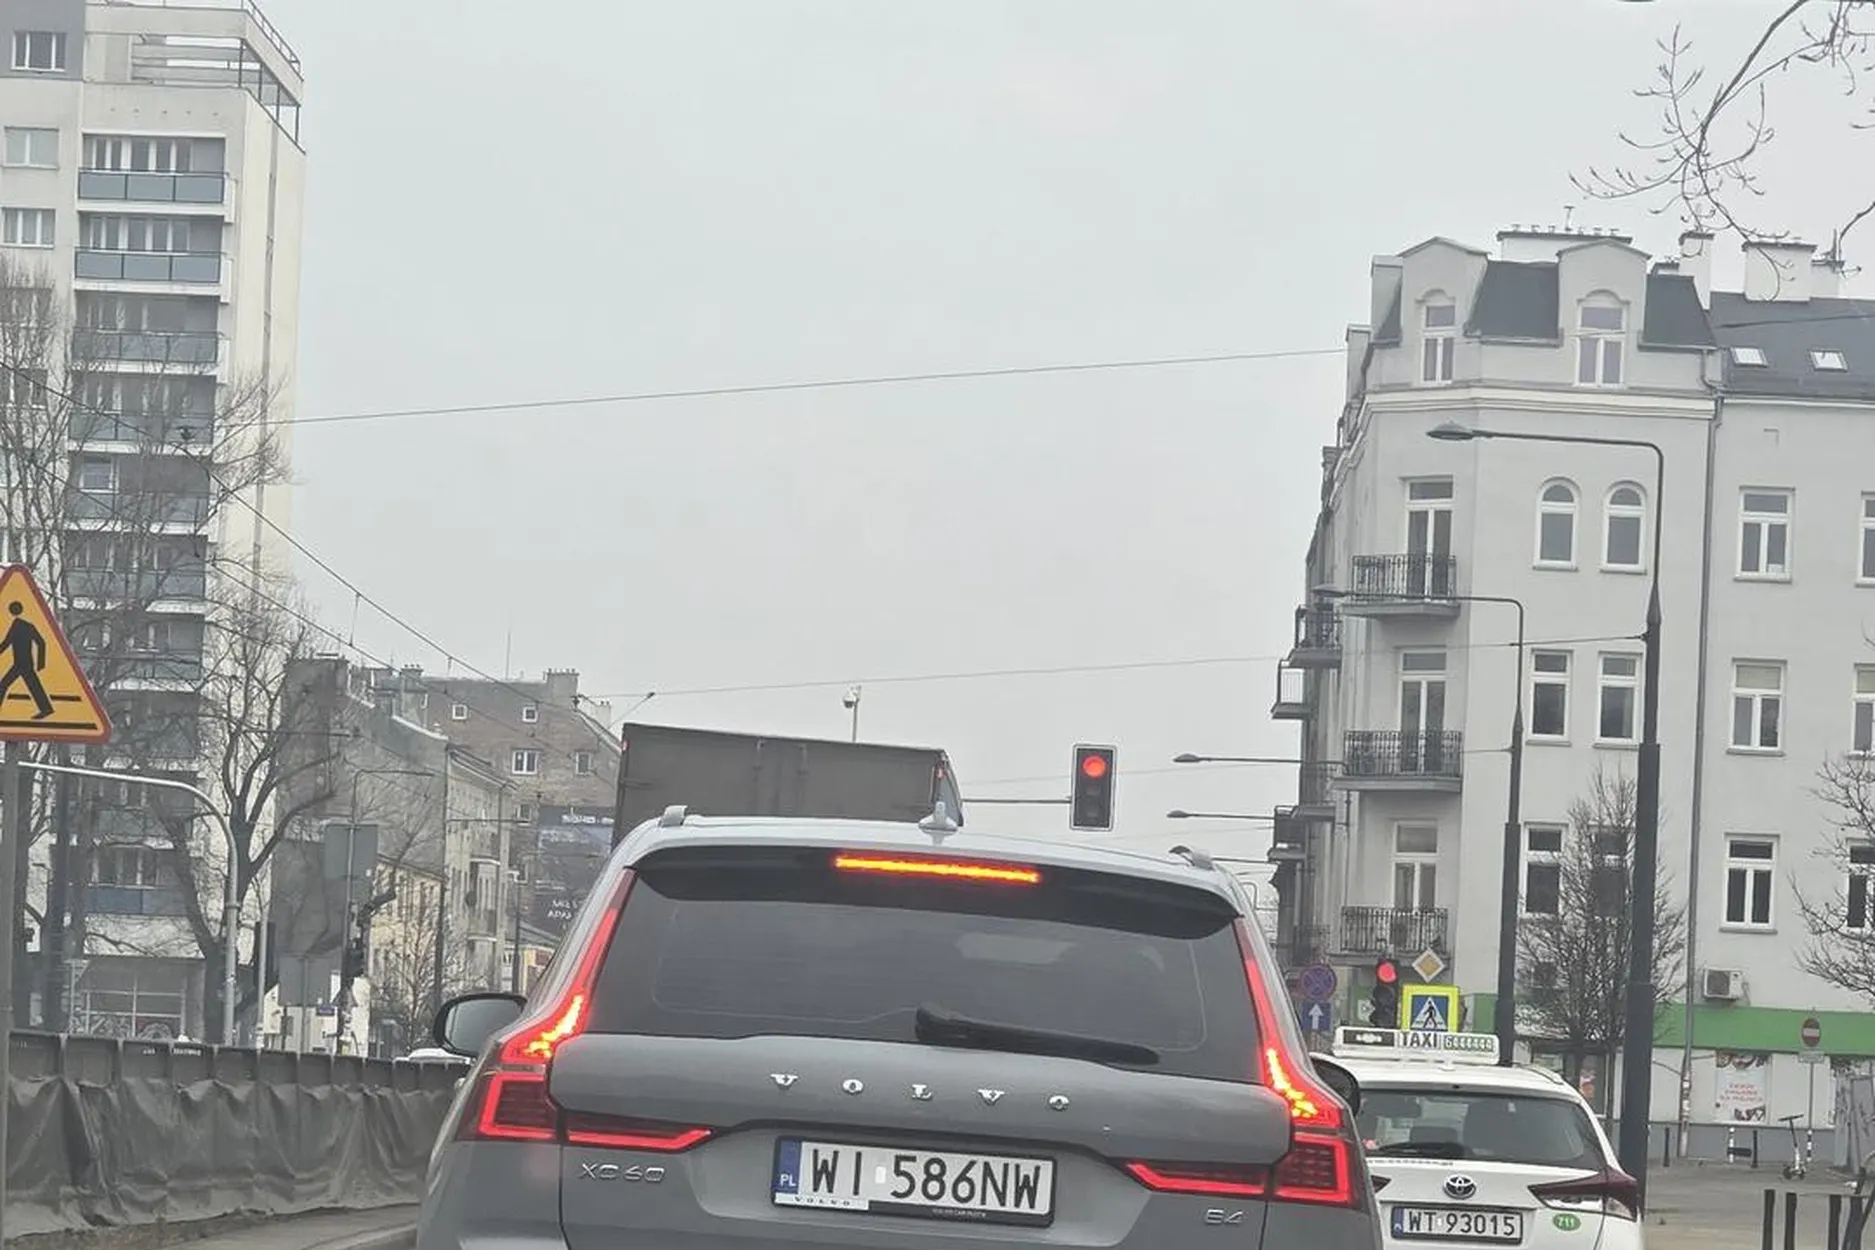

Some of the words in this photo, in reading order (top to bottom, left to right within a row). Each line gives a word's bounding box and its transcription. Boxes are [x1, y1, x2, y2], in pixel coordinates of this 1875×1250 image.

[1401, 1031, 1438, 1049] TAXI
[770, 1073, 1070, 1111] VOLVO
[581, 1163, 665, 1182] XC60
[780, 1173, 797, 1187] PL
[811, 1148, 862, 1195] WI
[890, 1155, 1040, 1209] 586NW
[1408, 1211, 1437, 1231] WT
[1446, 1212, 1515, 1236] 93015
